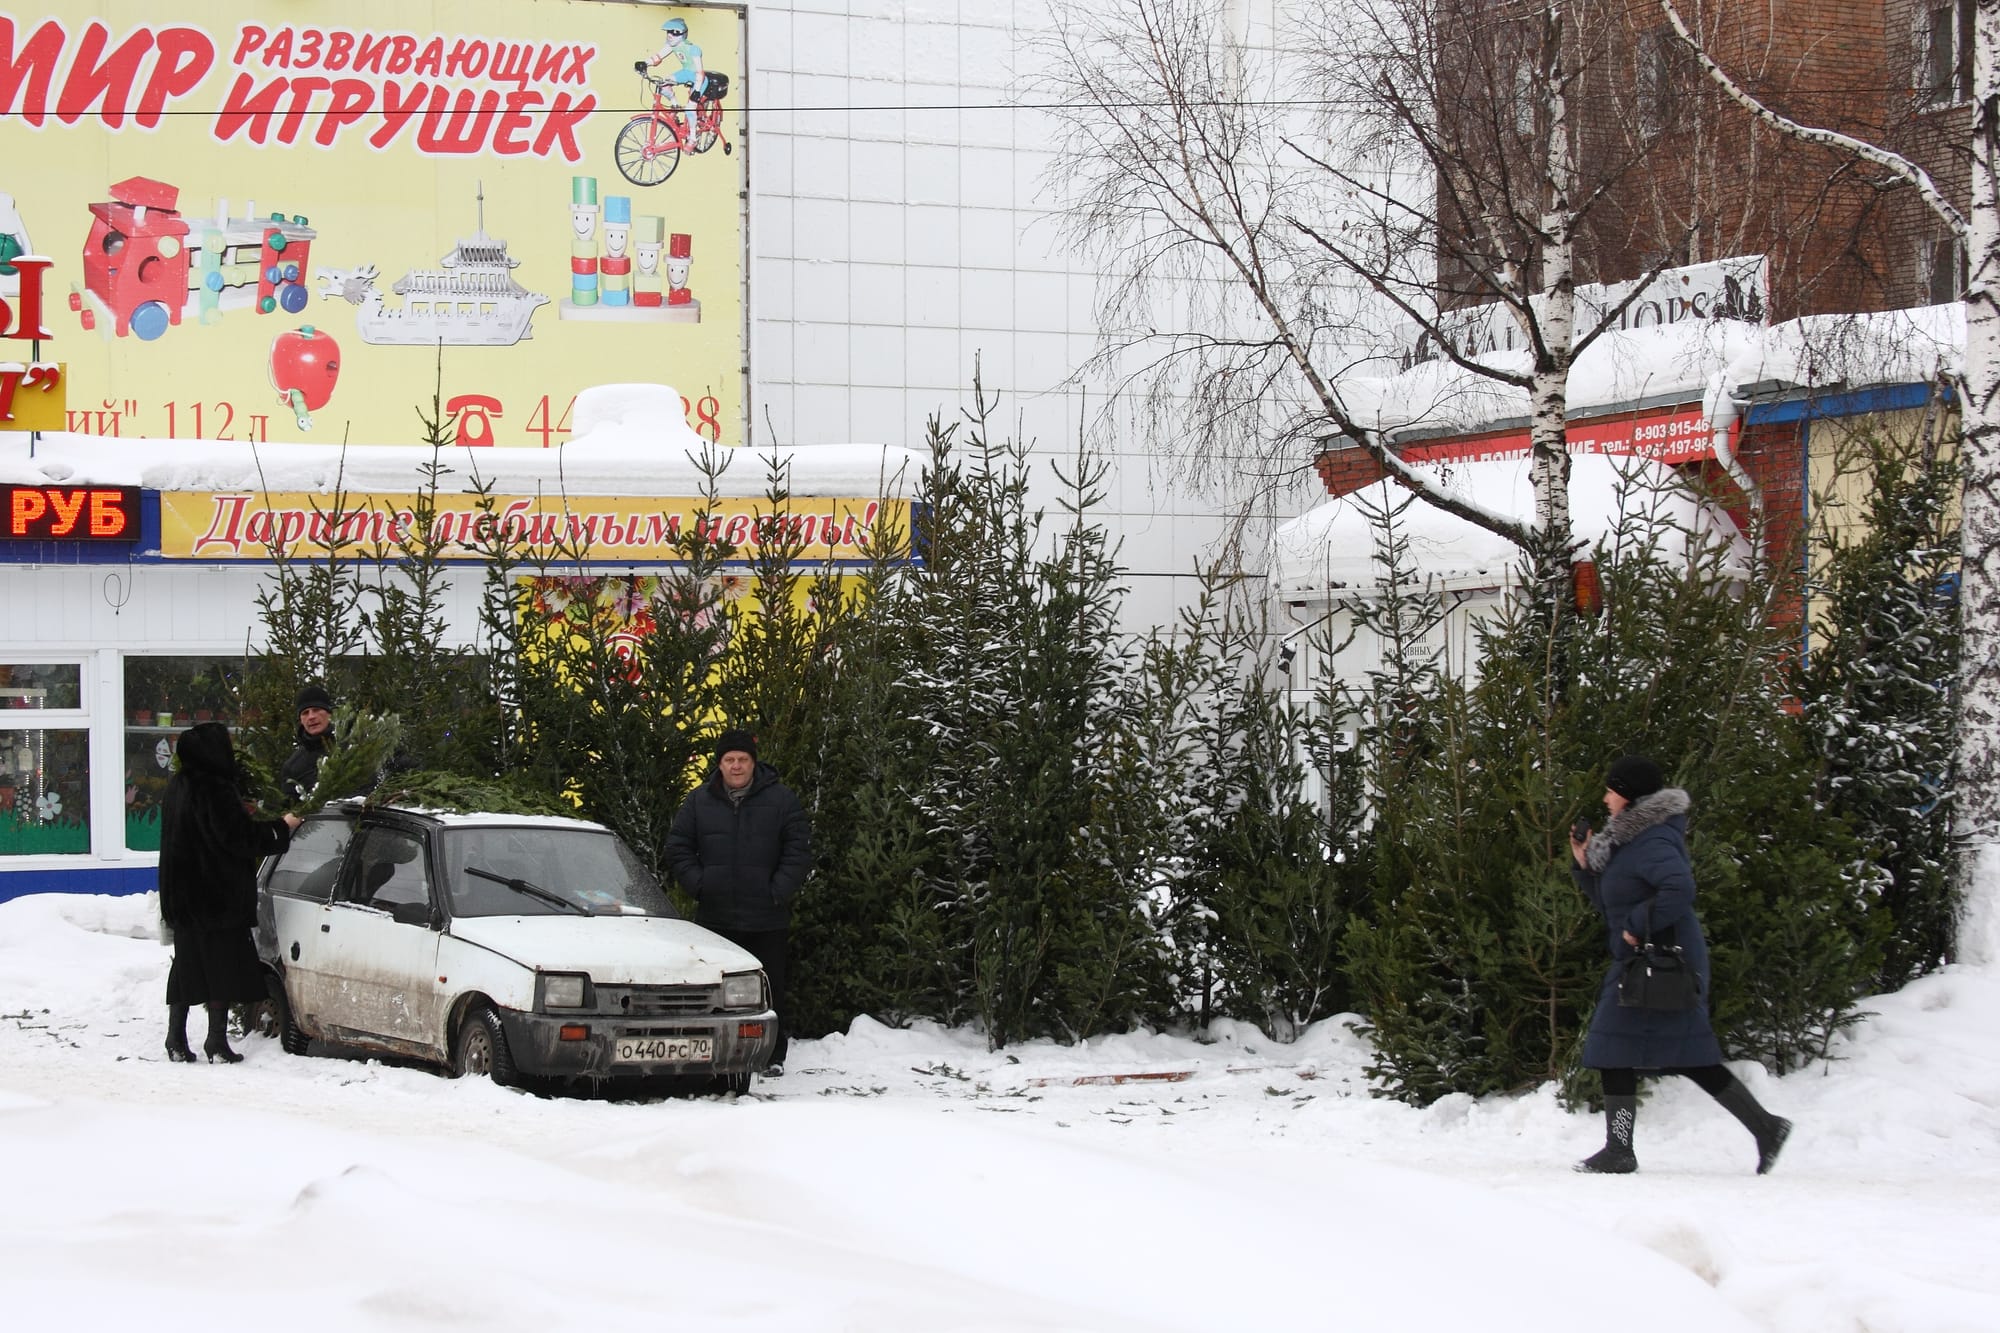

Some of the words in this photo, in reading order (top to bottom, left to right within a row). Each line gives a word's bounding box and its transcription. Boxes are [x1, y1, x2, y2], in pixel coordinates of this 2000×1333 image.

[0, 16, 214, 129] МИР
[233, 25, 595, 90] РАЗВИВАЮЩИХ
[214, 72, 597, 162] ИГРУШЕК
[163, 401, 234, 441] 112
[12, 489, 126, 536] РУБ
[193, 496, 413, 554] Дарите
[427, 500, 680, 546] любимым
[697, 502, 878, 548] цветы!
